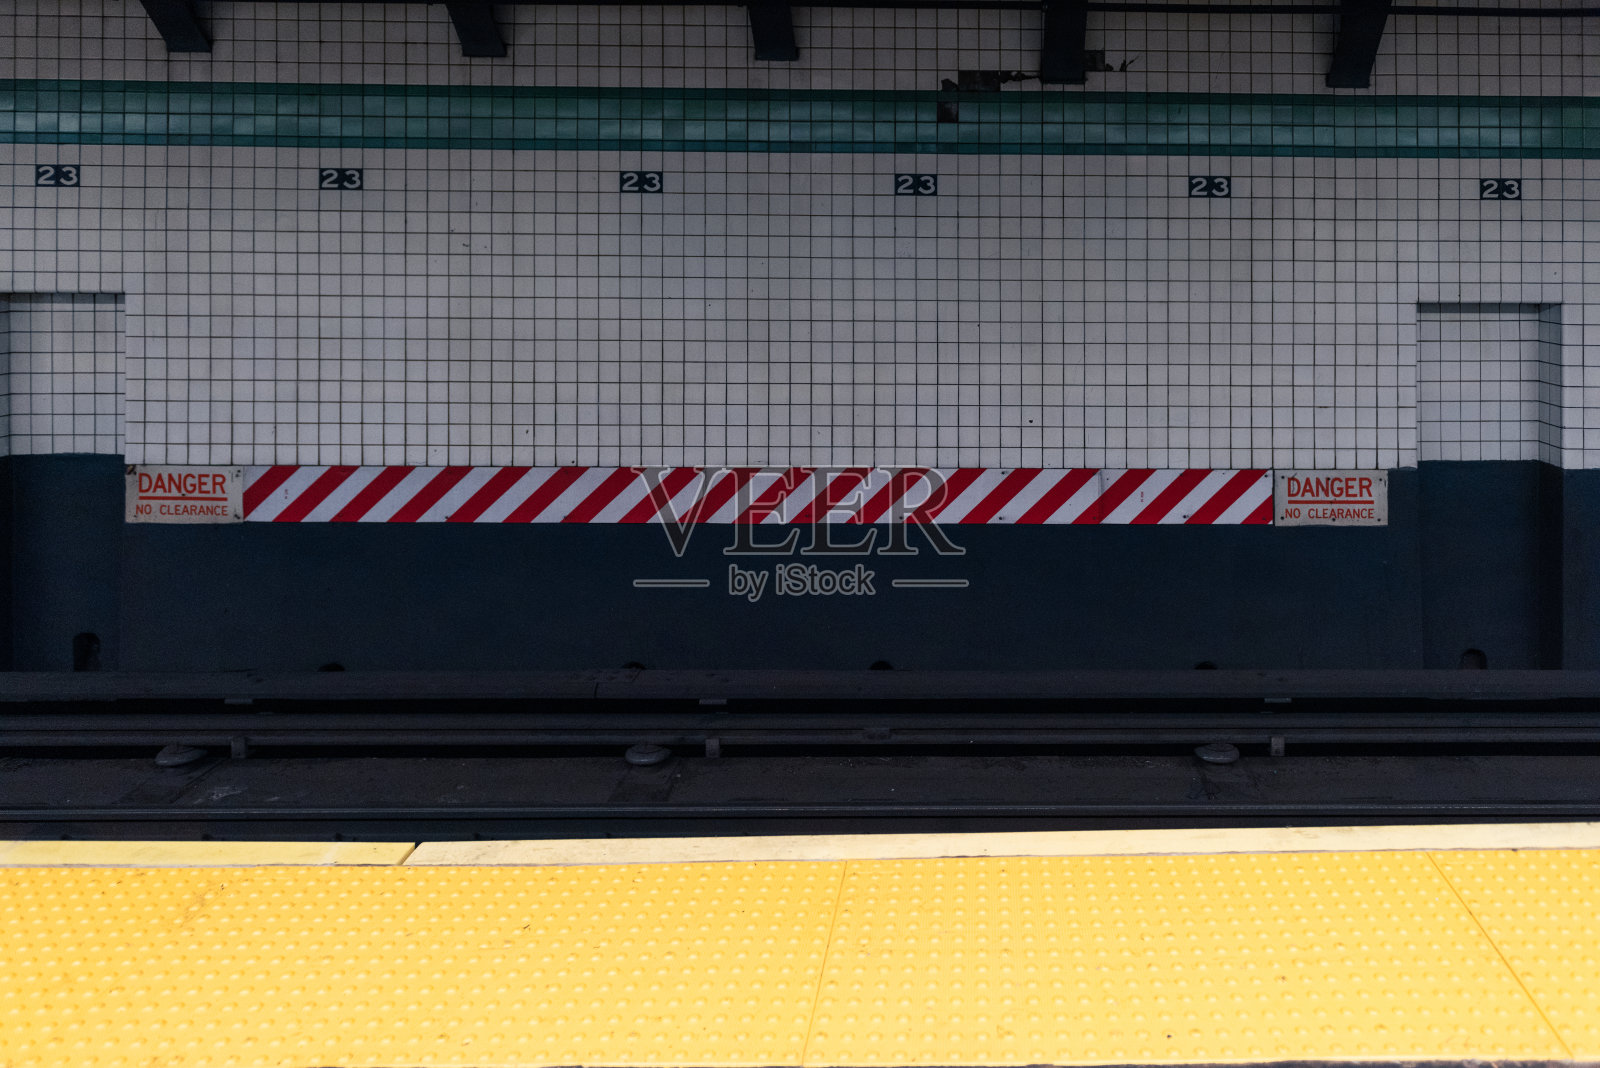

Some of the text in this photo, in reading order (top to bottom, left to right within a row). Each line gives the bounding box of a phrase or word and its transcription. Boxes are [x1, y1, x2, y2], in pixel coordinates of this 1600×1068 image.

[37, 165, 78, 186] 23
[321, 169, 361, 189] 23
[622, 172, 661, 192] 23
[897, 175, 936, 194] 23
[1190, 177, 1229, 197] 23
[1482, 179, 1520, 199] 23
[138, 472, 227, 495] DANGER
[1287, 477, 1373, 498] DANGER
[135, 504, 229, 517] NO CLEARANCE
[1285, 508, 1375, 519] NO CLEARANCE
